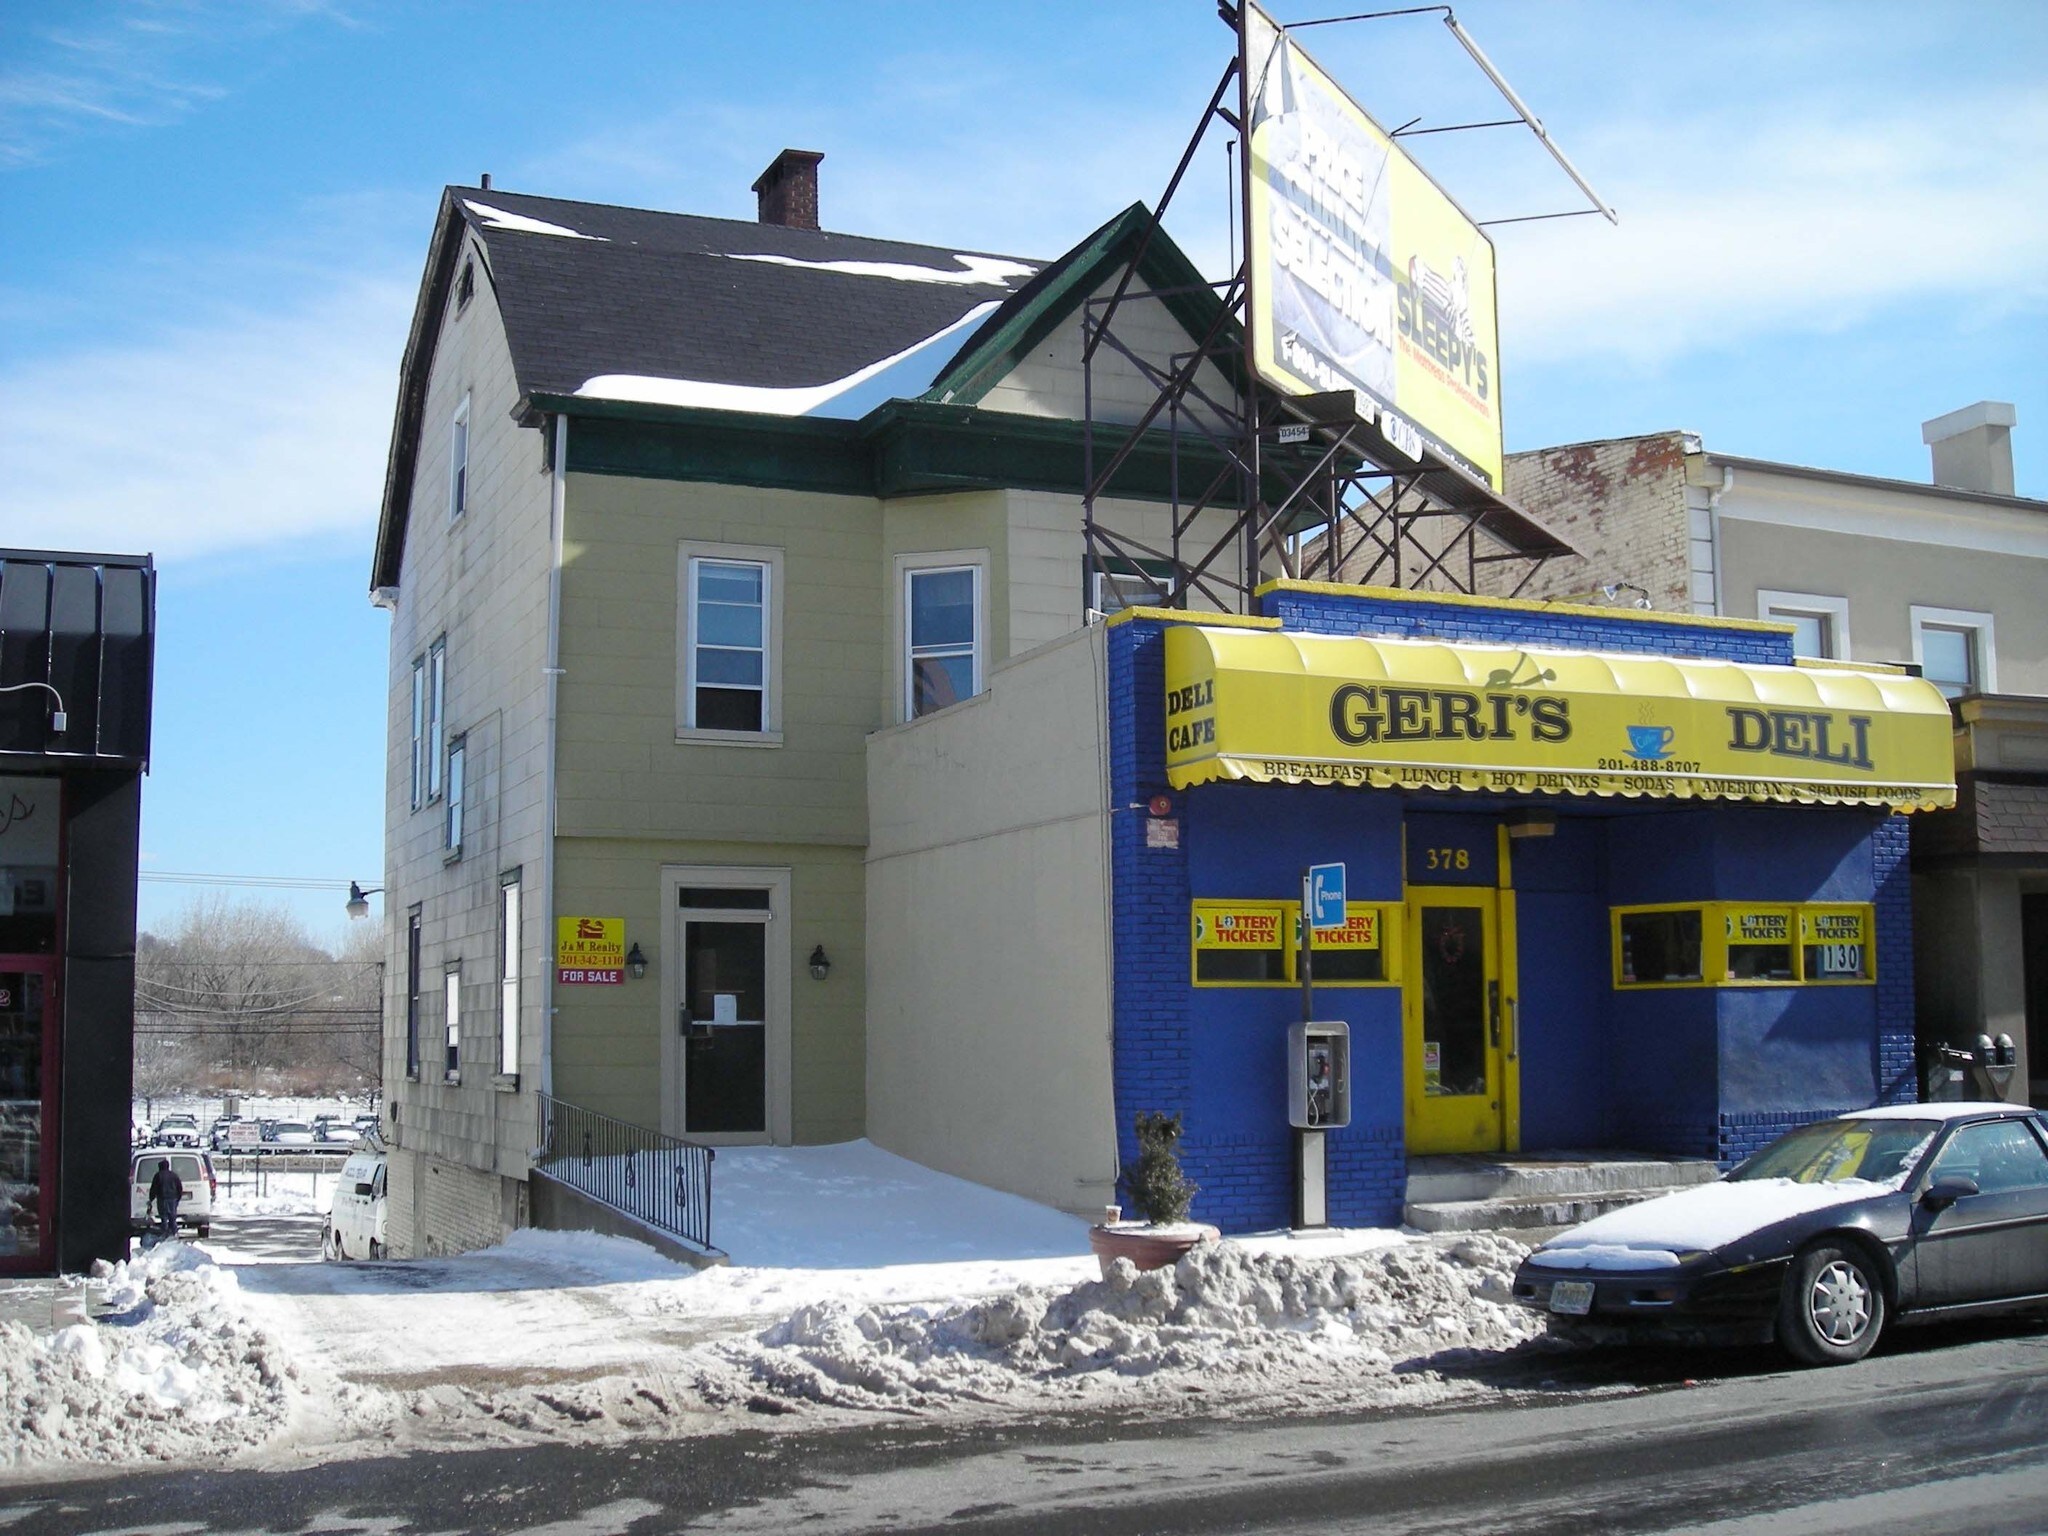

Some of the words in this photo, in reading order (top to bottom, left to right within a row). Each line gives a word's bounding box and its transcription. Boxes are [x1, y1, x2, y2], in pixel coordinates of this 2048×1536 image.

[1301, 117, 1363, 218] PRICE
[1286, 161, 1380, 286] QUALITY
[1274, 208, 1392, 352] SELECTION
[1397, 282, 1487, 400] SLEEPY'S
[1168, 679, 1213, 716] DELI
[1329, 682, 1572, 746] GERI'S
[1169, 717, 1215, 753] CAFE
[1726, 706, 1875, 771] DELI
[1598, 758, 1700, 773] 201-488-8707
[1263, 761, 1374, 781] BREAKFAST
[1402, 768, 1462, 784] LUNCH
[1492, 772, 1527, 786] HOT
[1536, 773, 1600, 788] DRINKS
[1624, 777, 1675, 791] SODAS
[1703, 780, 1785, 796] AMERICAN
[1790, 786, 1800, 797] &
[1808, 784, 1868, 799] SPANISH
[1876, 787, 1922, 800] FOODS
[1427, 849, 1469, 870] 378
[1320, 890, 1342, 900] Phone
[1215, 915, 1278, 928] LOTTERY
[1740, 914, 1788, 927] LOTTERY
[1814, 915, 1860, 927] LOTTERY
[1216, 930, 1275, 942] TICKETS
[1315, 930, 1371, 943] TICKETS
[1742, 927, 1787, 939] TICKETS
[1816, 927, 1859, 939] TICKETS
[590, 941, 621, 953] Realty
[562, 971, 584, 981] FOR
[588, 971, 617, 982] SALE
